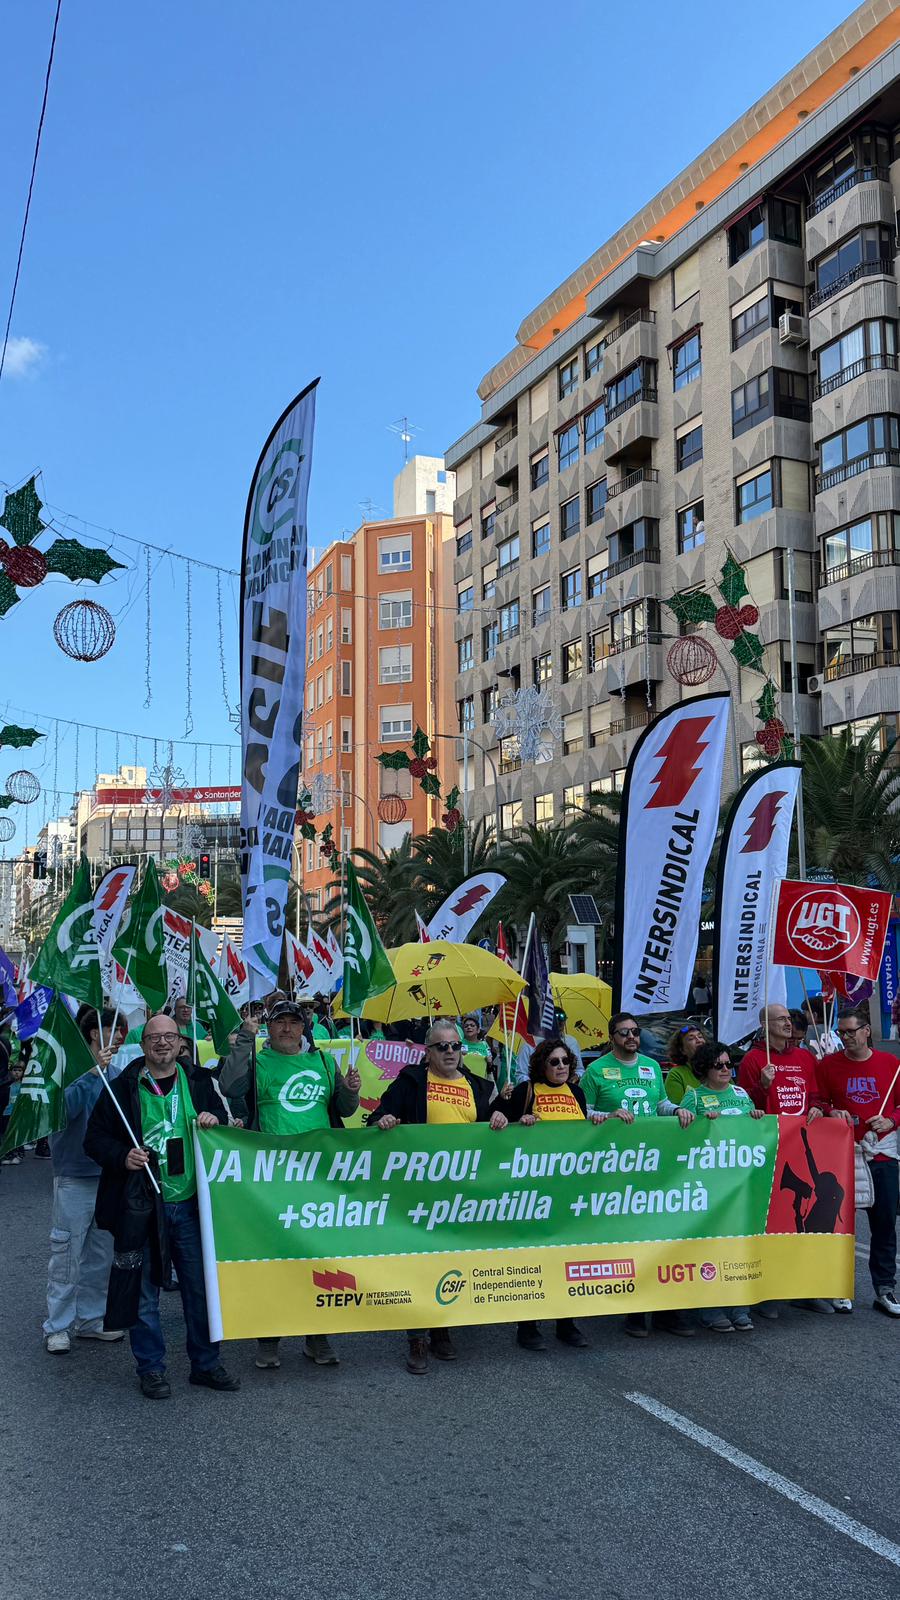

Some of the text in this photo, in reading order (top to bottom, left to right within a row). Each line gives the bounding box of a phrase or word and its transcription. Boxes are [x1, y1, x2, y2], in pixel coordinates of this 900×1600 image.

[204, 790, 241, 799] Santander
[633, 808, 700, 1005] INTERSINDICAL
[795, 902, 850, 931] UGT
[733, 870, 762, 1011] INTERSINDICAL
[860, 902, 879, 965] www.ugt.es
[885, 955, 894, 1006] CHANGE
[289, 1083, 327, 1100] CSIF
[847, 1077, 876, 1093] UGT
[427, 1093, 471, 1108] educació
[206, 1139, 766, 1182] JA N'HI HA PROU! -burocràcia -ràtios
[278, 1181, 708, 1231] +salari +plantilla +valencià
[472, 1264, 542, 1277] Central Sindical
[657, 1263, 697, 1284] UGT
[441, 1280, 467, 1294] CSIF
[473, 1278, 543, 1291] Independiente y
[567, 1279, 635, 1297] educació
[315, 1292, 363, 1308] STEPV
[366, 1290, 411, 1299] INTERSINDICAL
[373, 1297, 412, 1306] VALENCIANA
[474, 1291, 545, 1304] de Funcionarios
